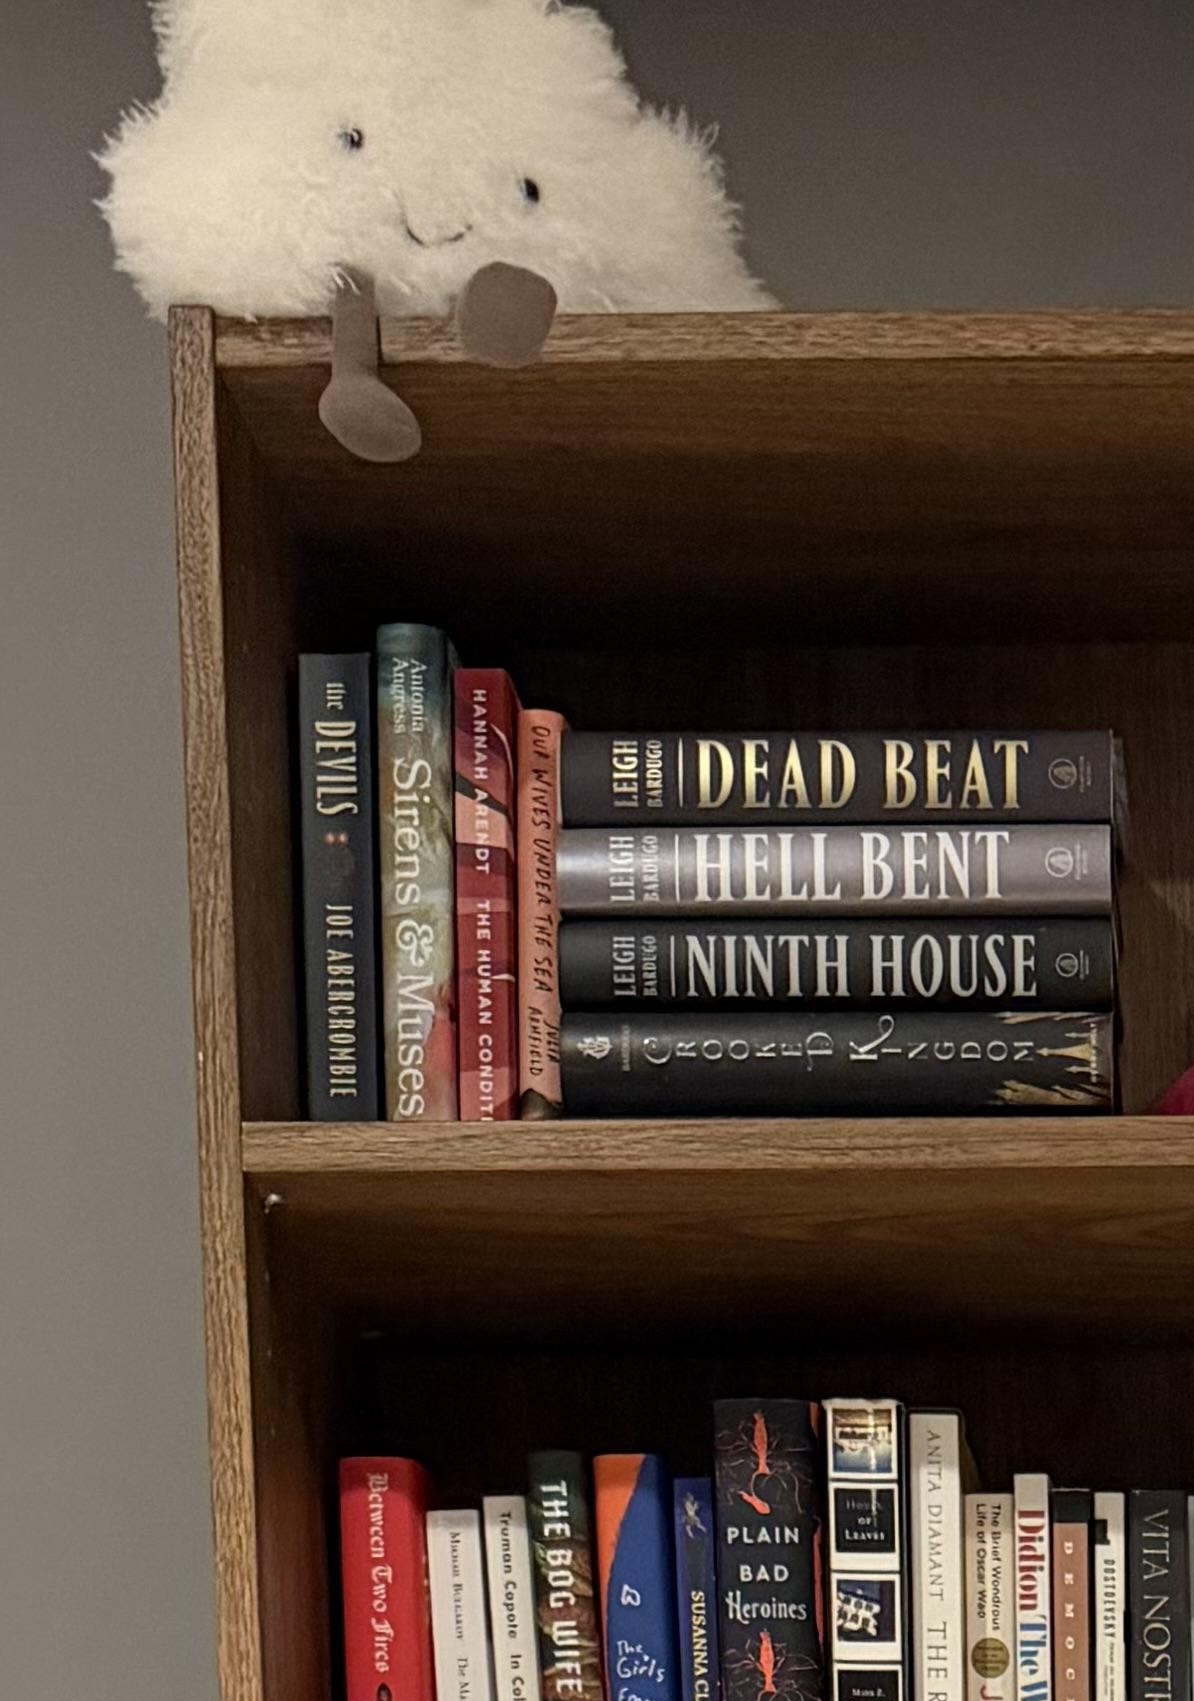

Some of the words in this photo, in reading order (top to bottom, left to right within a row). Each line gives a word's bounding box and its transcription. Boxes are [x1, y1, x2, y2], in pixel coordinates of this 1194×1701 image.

[326, 683, 344, 710] the
[392, 657, 406, 734] Angress
[410, 659, 423, 733] Antonia
[314, 721, 358, 815] DEVILS
[696, 738, 857, 810] DEAD
[882, 738, 1029, 810] BEAT
[392, 758, 431, 904] Sirens
[694, 832, 841, 902] HELL
[861, 830, 1009, 901] BENT
[325, 905, 356, 940] JOE
[395, 920, 434, 966] &
[686, 934, 851, 998] NINTH
[870, 934, 1037, 998] HOUSE
[325, 949, 357, 1098] ABERCROMBIE
[396, 970, 434, 1117] Muses
[540, 1481, 571, 1537] THE
[728, 1527, 799, 1544] PLAIN
[500, 1512, 514, 1574] Truman
[739, 1566, 789, 1582] BAD
[1143, 1509, 1169, 1579] VITA
[545, 1549, 575, 1608] BOG
[725, 1590, 807, 1622] Heroines
[510, 1654, 519, 1669] In
[551, 1621, 583, 1694] WIFE
